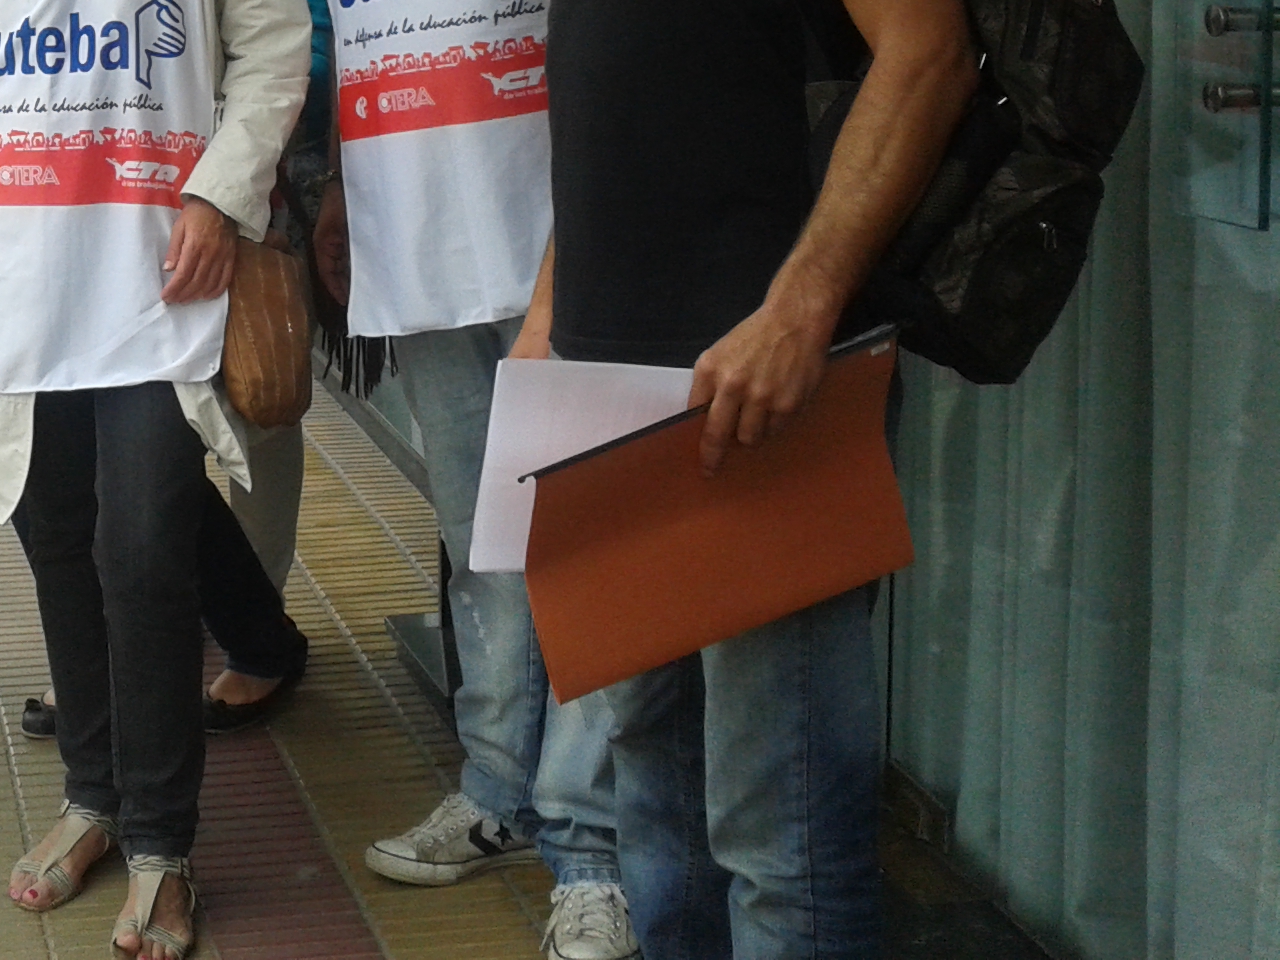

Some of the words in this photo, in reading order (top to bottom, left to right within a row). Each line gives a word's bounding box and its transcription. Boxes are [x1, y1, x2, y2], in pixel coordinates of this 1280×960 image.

[386, 21, 398, 37] de
[401, 16, 415, 34] la
[418, 10, 489, 32] educación
[493, 0, 545, 26] pública
[17, 98, 30, 114] de
[34, 97, 47, 113] la
[51, 96, 118, 113] educación
[122, 93, 164, 115] pública
[377, 86, 436, 113] CTERA
[500, 66, 545, 91] CT
